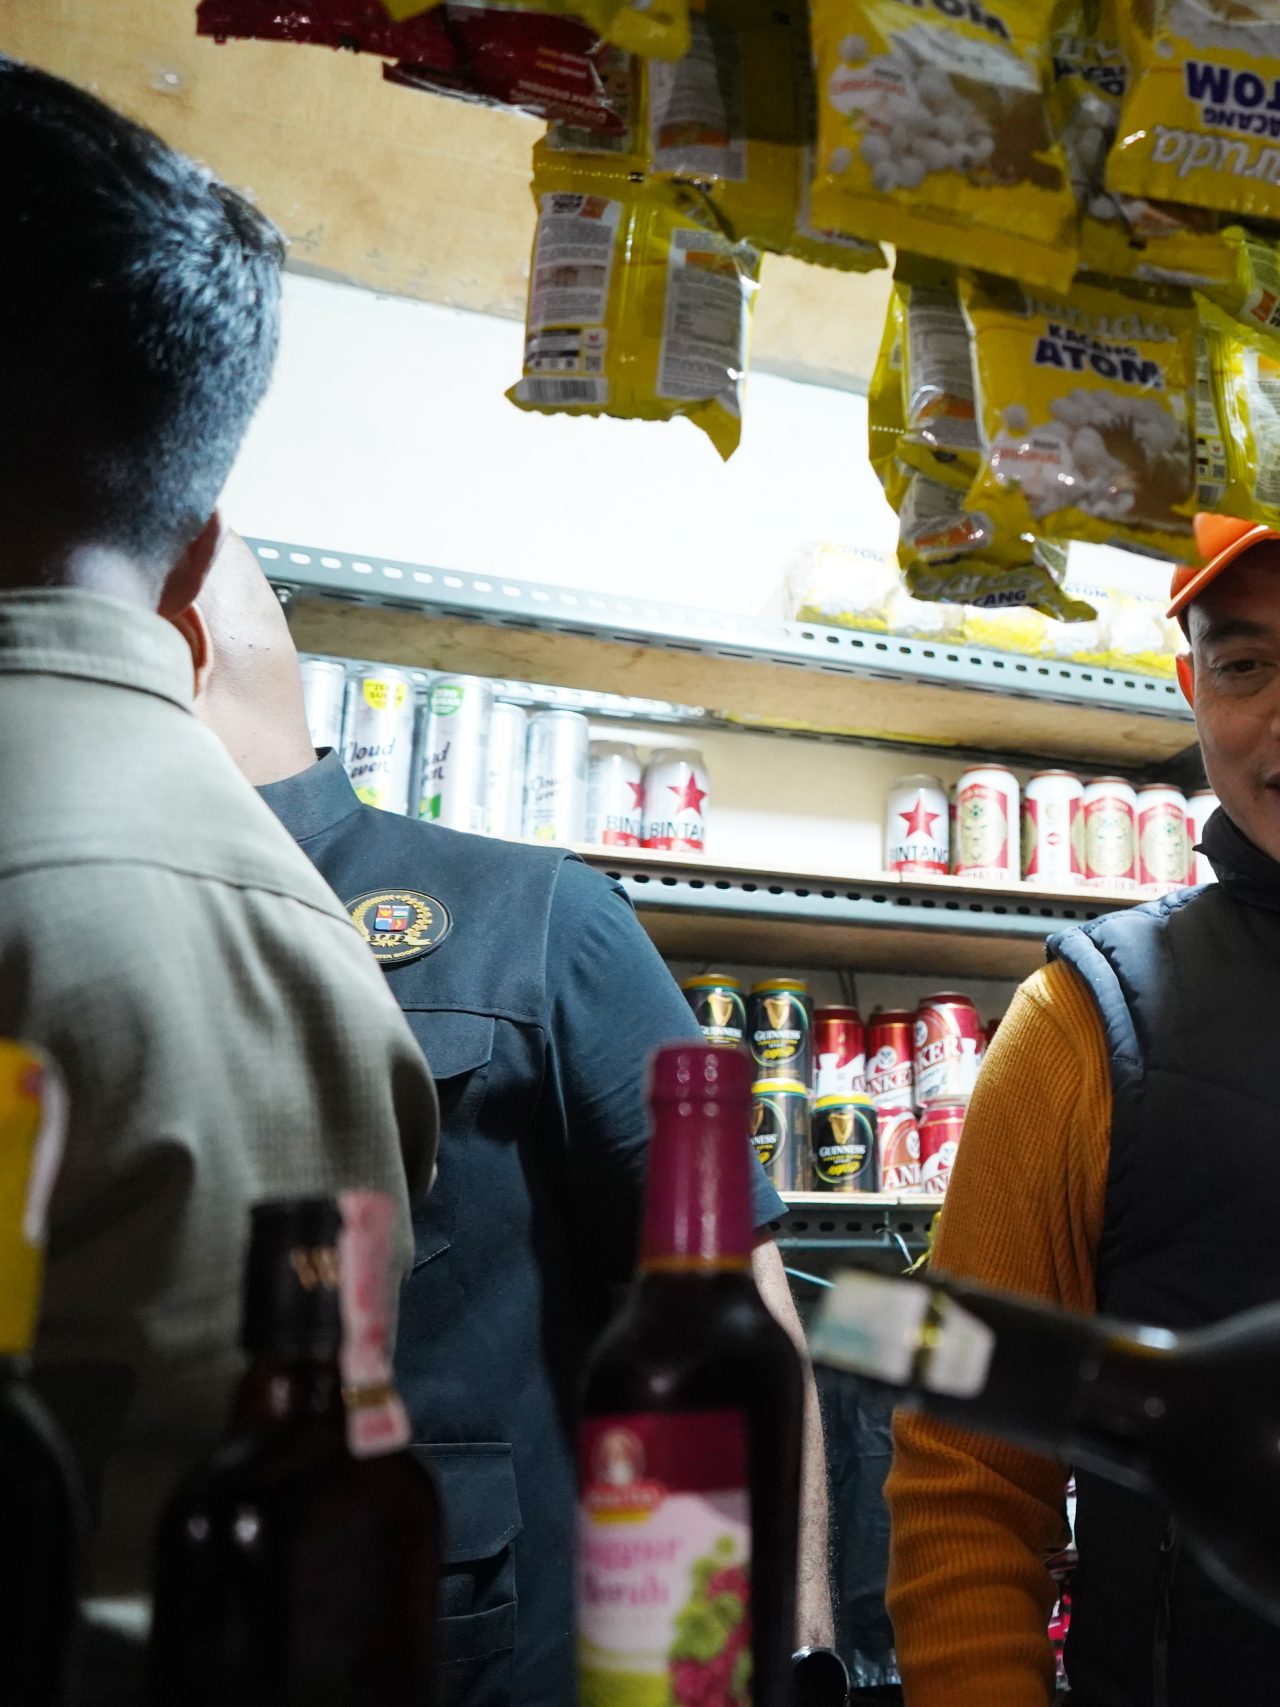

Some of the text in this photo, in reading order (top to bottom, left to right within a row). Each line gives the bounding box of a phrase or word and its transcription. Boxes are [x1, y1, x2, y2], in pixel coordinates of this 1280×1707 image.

[1047, 323, 1140, 358] KACANG
[1033, 336, 1164, 389] ATOM
[753, 1029, 801, 1042] GUINNESS
[818, 1144, 866, 1157] GUINNESS
